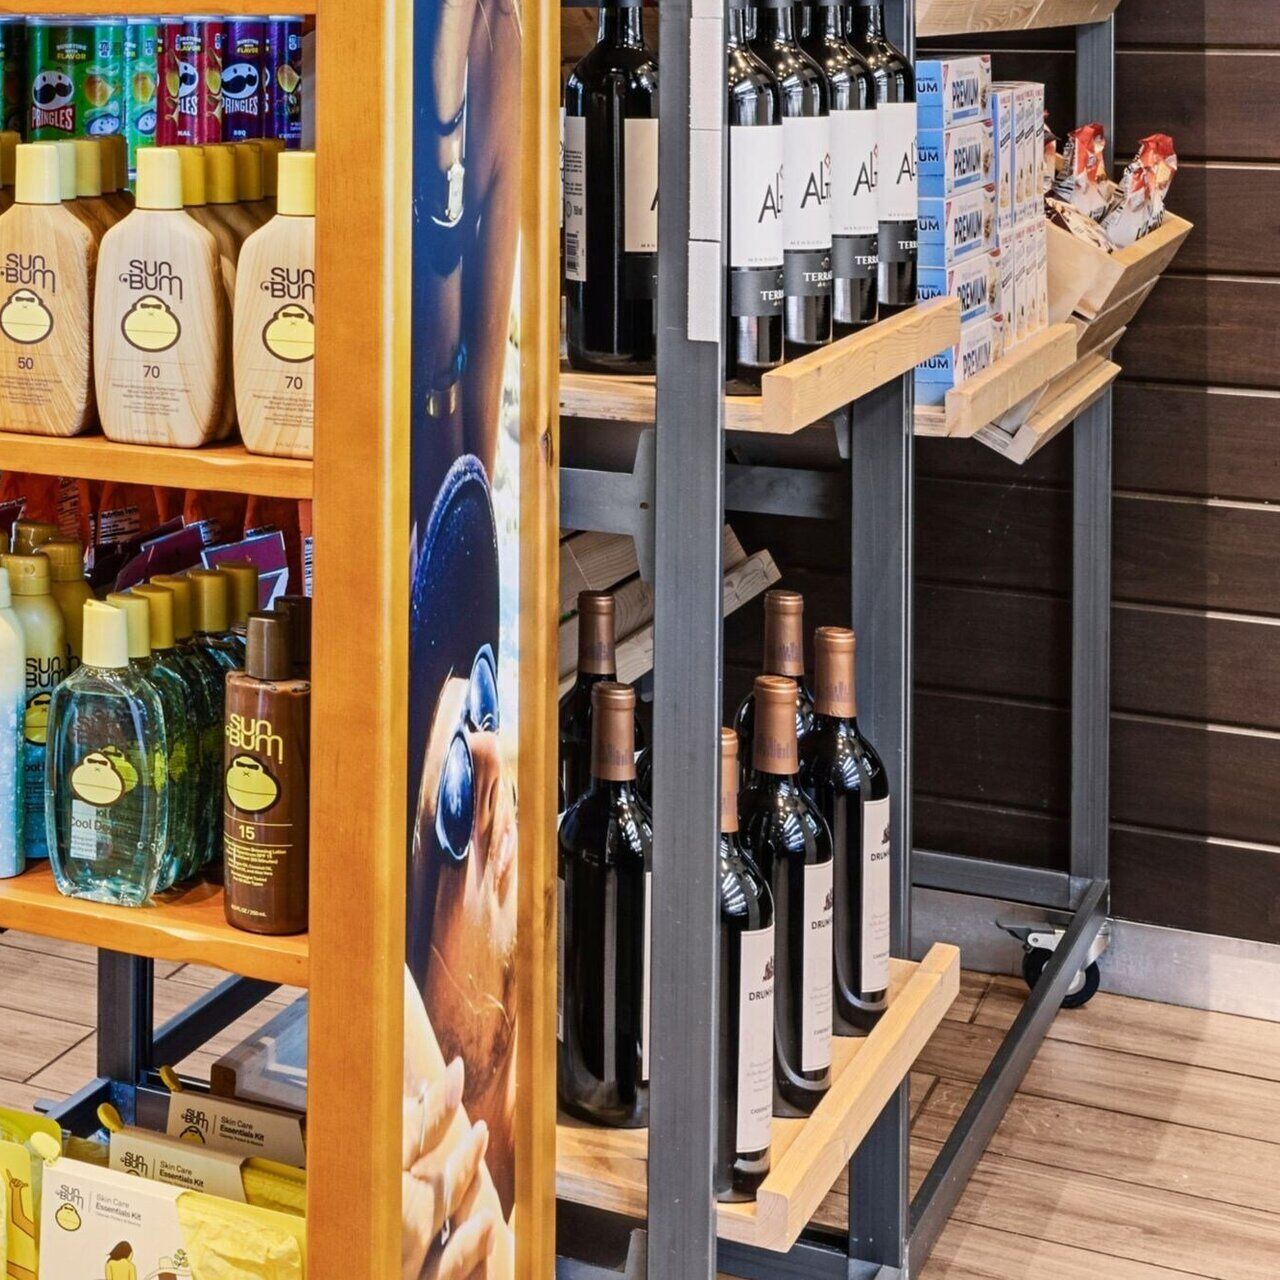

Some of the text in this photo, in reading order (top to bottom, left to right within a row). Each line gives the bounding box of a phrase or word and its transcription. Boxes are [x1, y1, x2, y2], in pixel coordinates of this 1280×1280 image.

[951, 78, 979, 110] PREMIUM
[32, 104, 73, 130] PRINGLES
[953, 144, 981, 176] PREMIUM
[954, 211, 982, 245] PREMIUM
[18, 356, 34, 370] 50
[143, 365, 160, 379] 70
[285, 376, 303, 390] 70
[238, 825, 256, 840] 15
